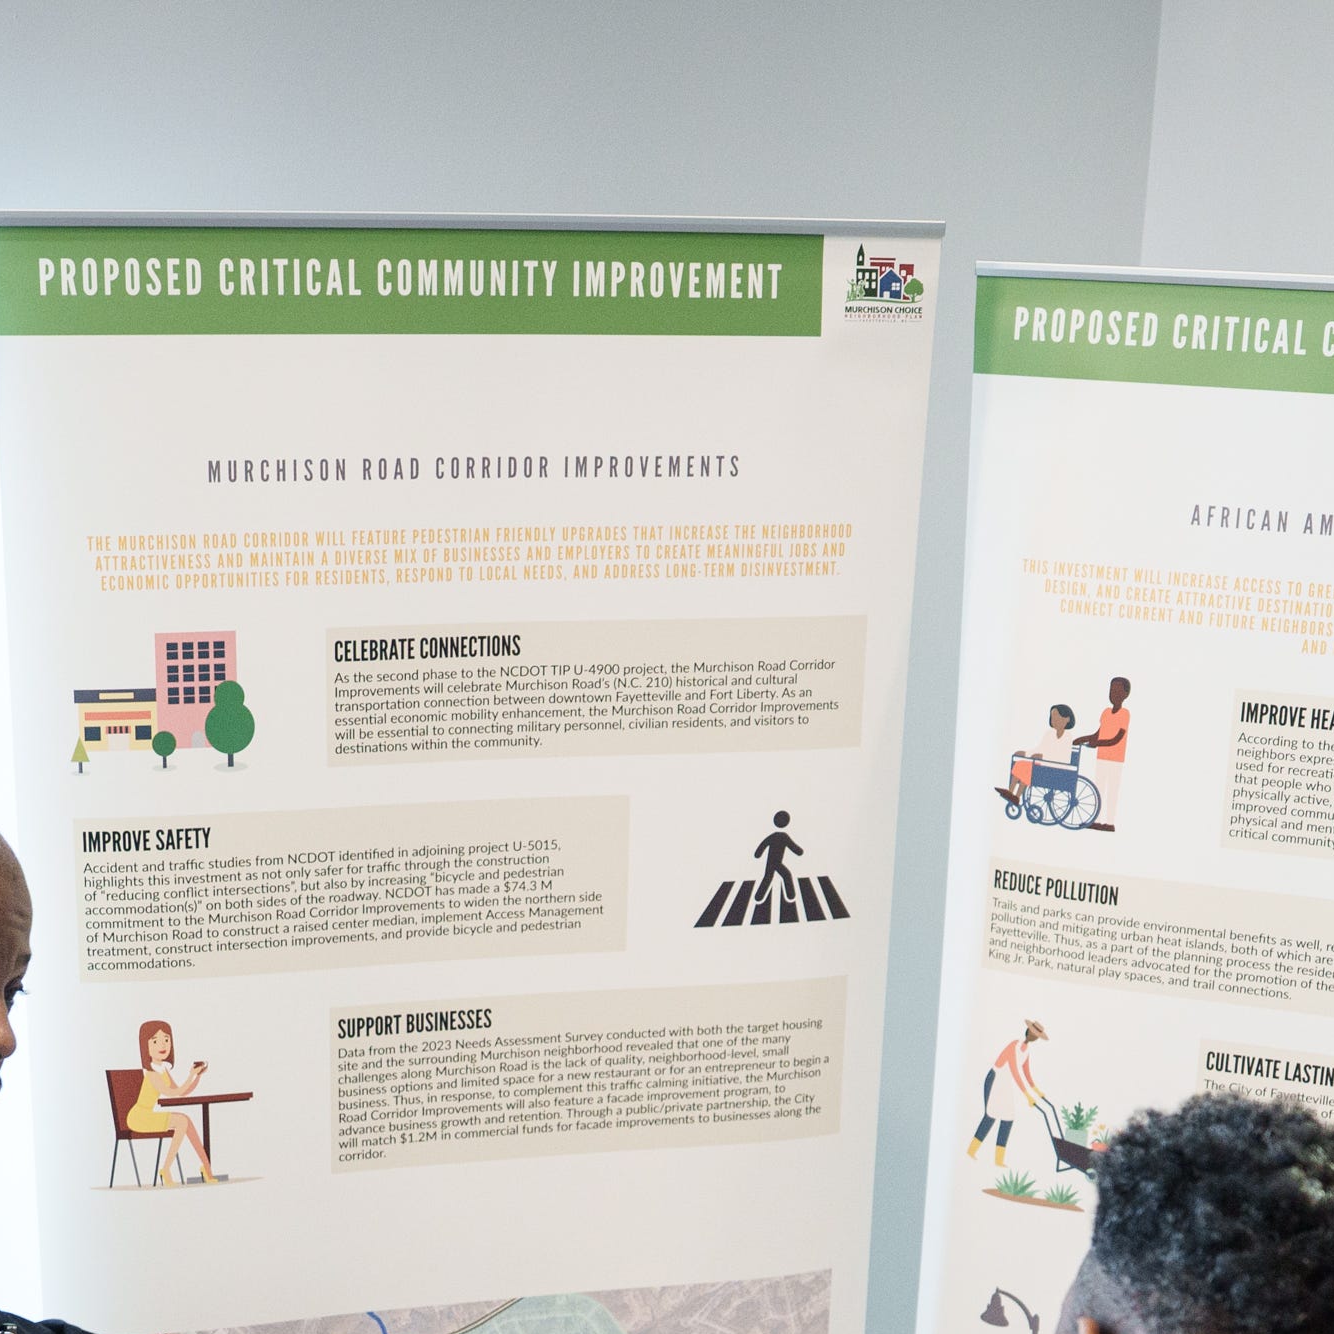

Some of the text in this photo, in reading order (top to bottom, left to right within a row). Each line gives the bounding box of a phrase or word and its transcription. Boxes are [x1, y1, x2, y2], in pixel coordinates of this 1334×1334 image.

[38, 257, 782, 299] PROPOSED CRITICAL COMMUNITY IMPROVEMENT
[844, 306, 922, 314] MURCHISON CHOICE
[1013, 306, 1158, 347] PROPOSED
[1172, 313, 1306, 355] CRITICAL
[208, 455, 739, 483] MURCHISON ROAD CORRIDOR IMPROVEMENTS
[1190, 504, 1288, 532] AFRICAN
[334, 634, 521, 662] CELEBRATE CONNECTIONS
[1301, 639, 1327, 655] AND
[1240, 701, 1307, 728] IMPROVE
[1237, 731, 1298, 751] According
[1302, 739, 1314, 750] to
[82, 827, 210, 853] IMPROVE SAFETY
[994, 869, 1119, 906] REDUCE POLLUTION
[338, 1008, 492, 1039] SUPPORT BUSINESSES
[1206, 1051, 1281, 1079] CULTIVATE
